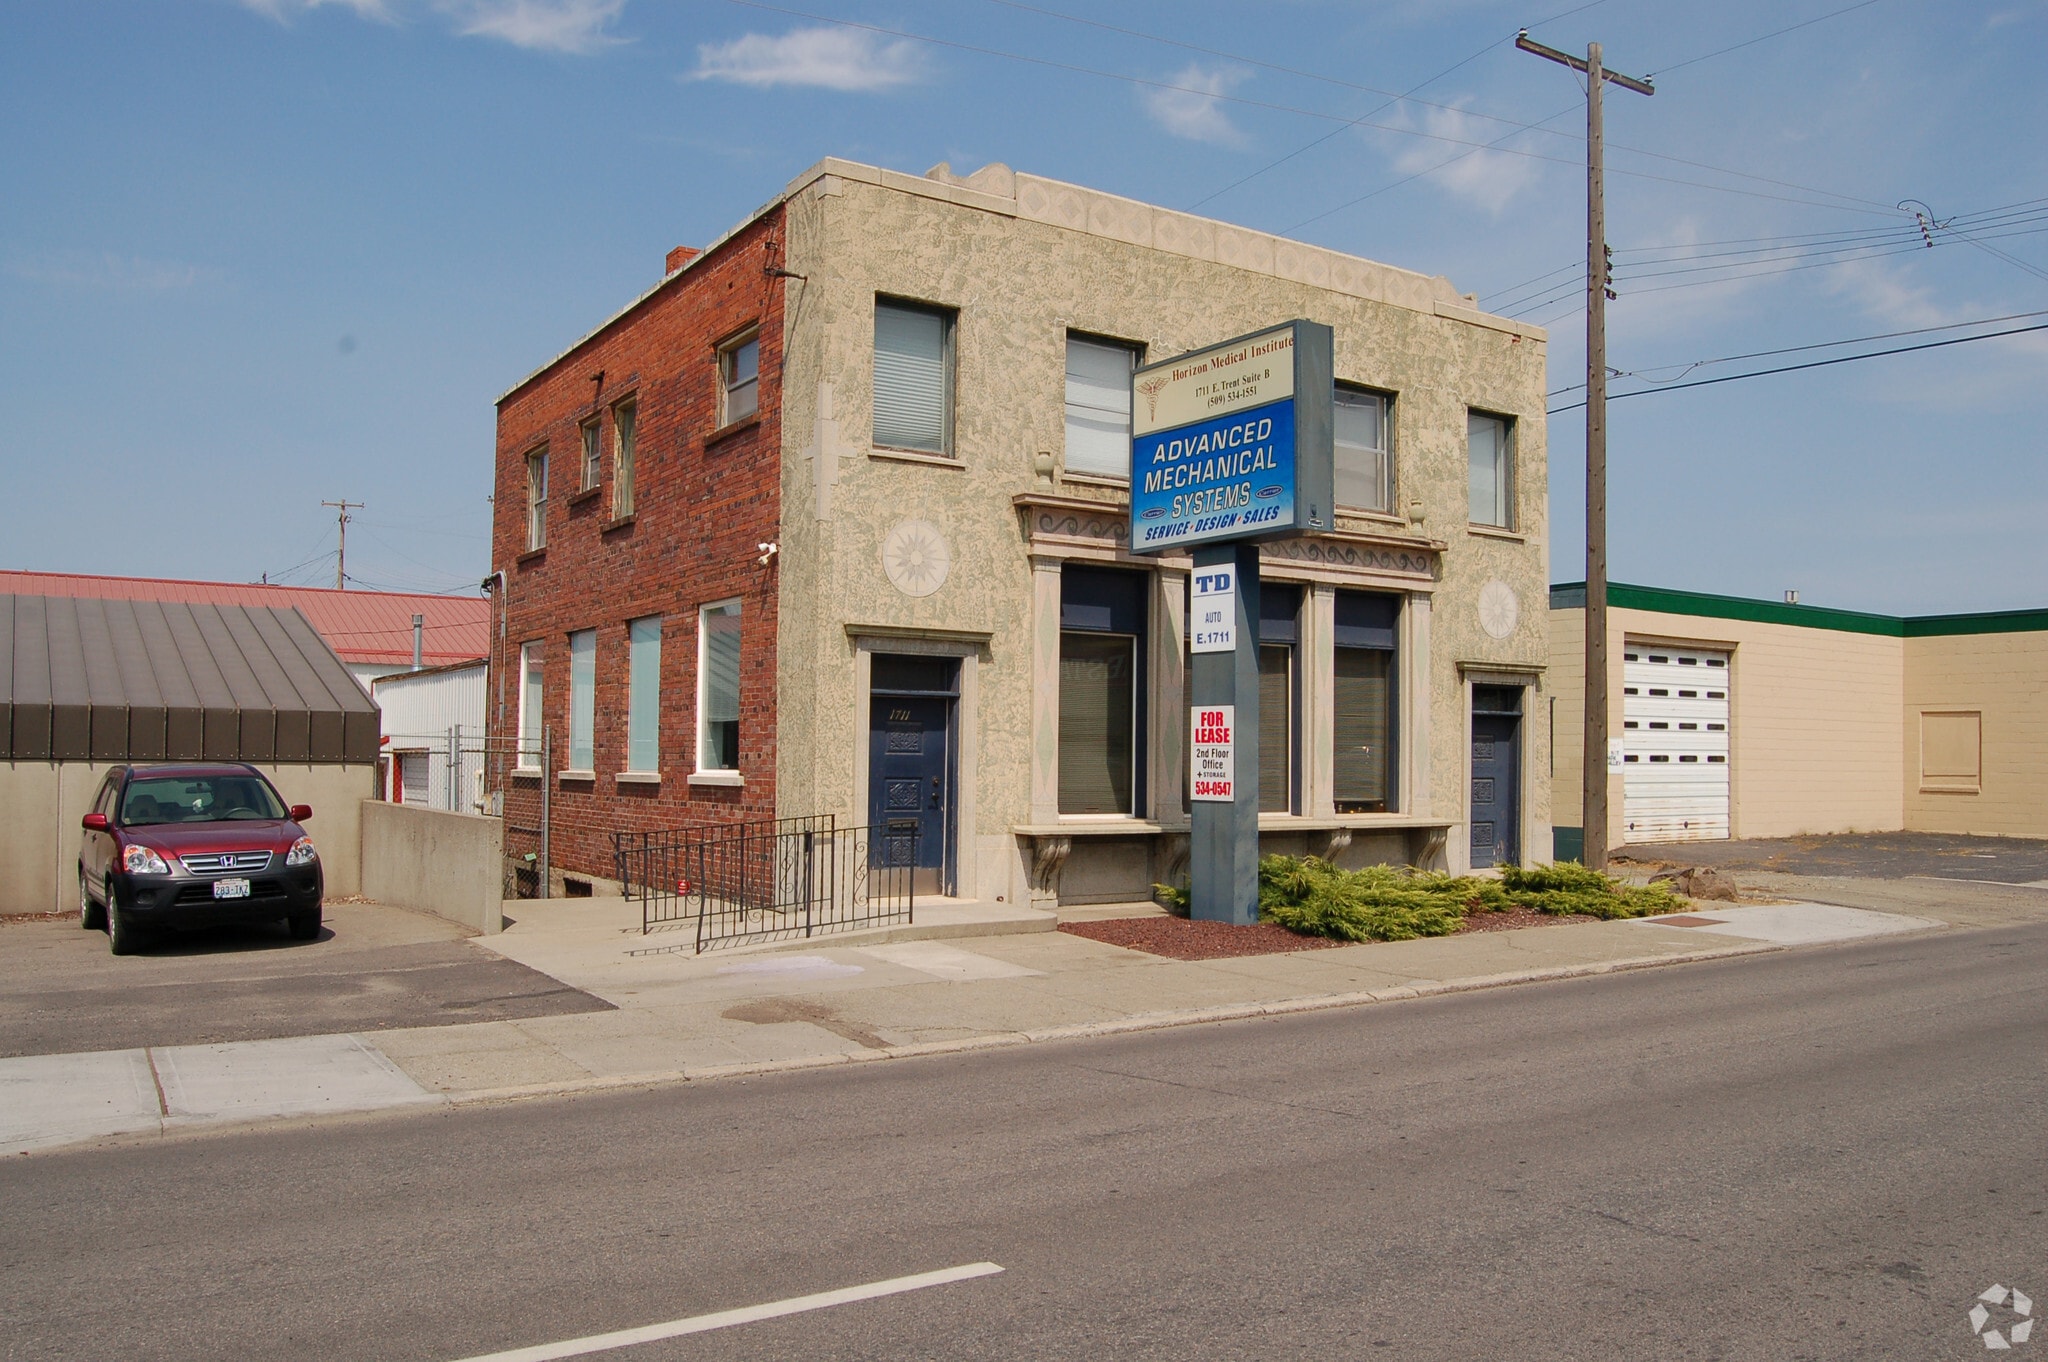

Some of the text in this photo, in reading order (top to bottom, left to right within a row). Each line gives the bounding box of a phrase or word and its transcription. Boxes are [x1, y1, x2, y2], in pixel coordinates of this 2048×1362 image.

[1172, 337, 1295, 382] Horizon Medical Institute
[1195, 368, 1270, 398] 1711 E. Trent Suite B
[1207, 385, 1257, 409] (509) 534-1551
[1152, 418, 1272, 465] ADVANCED
[1144, 445, 1277, 494] MECHANICAL
[1171, 481, 1251, 518] SYSTEMS
[1145, 505, 1280, 541] SERVICE DESIGN SALES
[1195, 573, 1230, 593] TD
[1205, 611, 1222, 624] AUTO
[1196, 631, 1229, 644] E.1711
[890, 709, 910, 720] 1711
[1200, 711, 1223, 727] FOR
[1195, 728, 1230, 743] LEASE
[1196, 748, 1229, 758] 2nd Floor
[1202, 759, 1223, 769] Office
[1195, 781, 1231, 796] 534-0547
